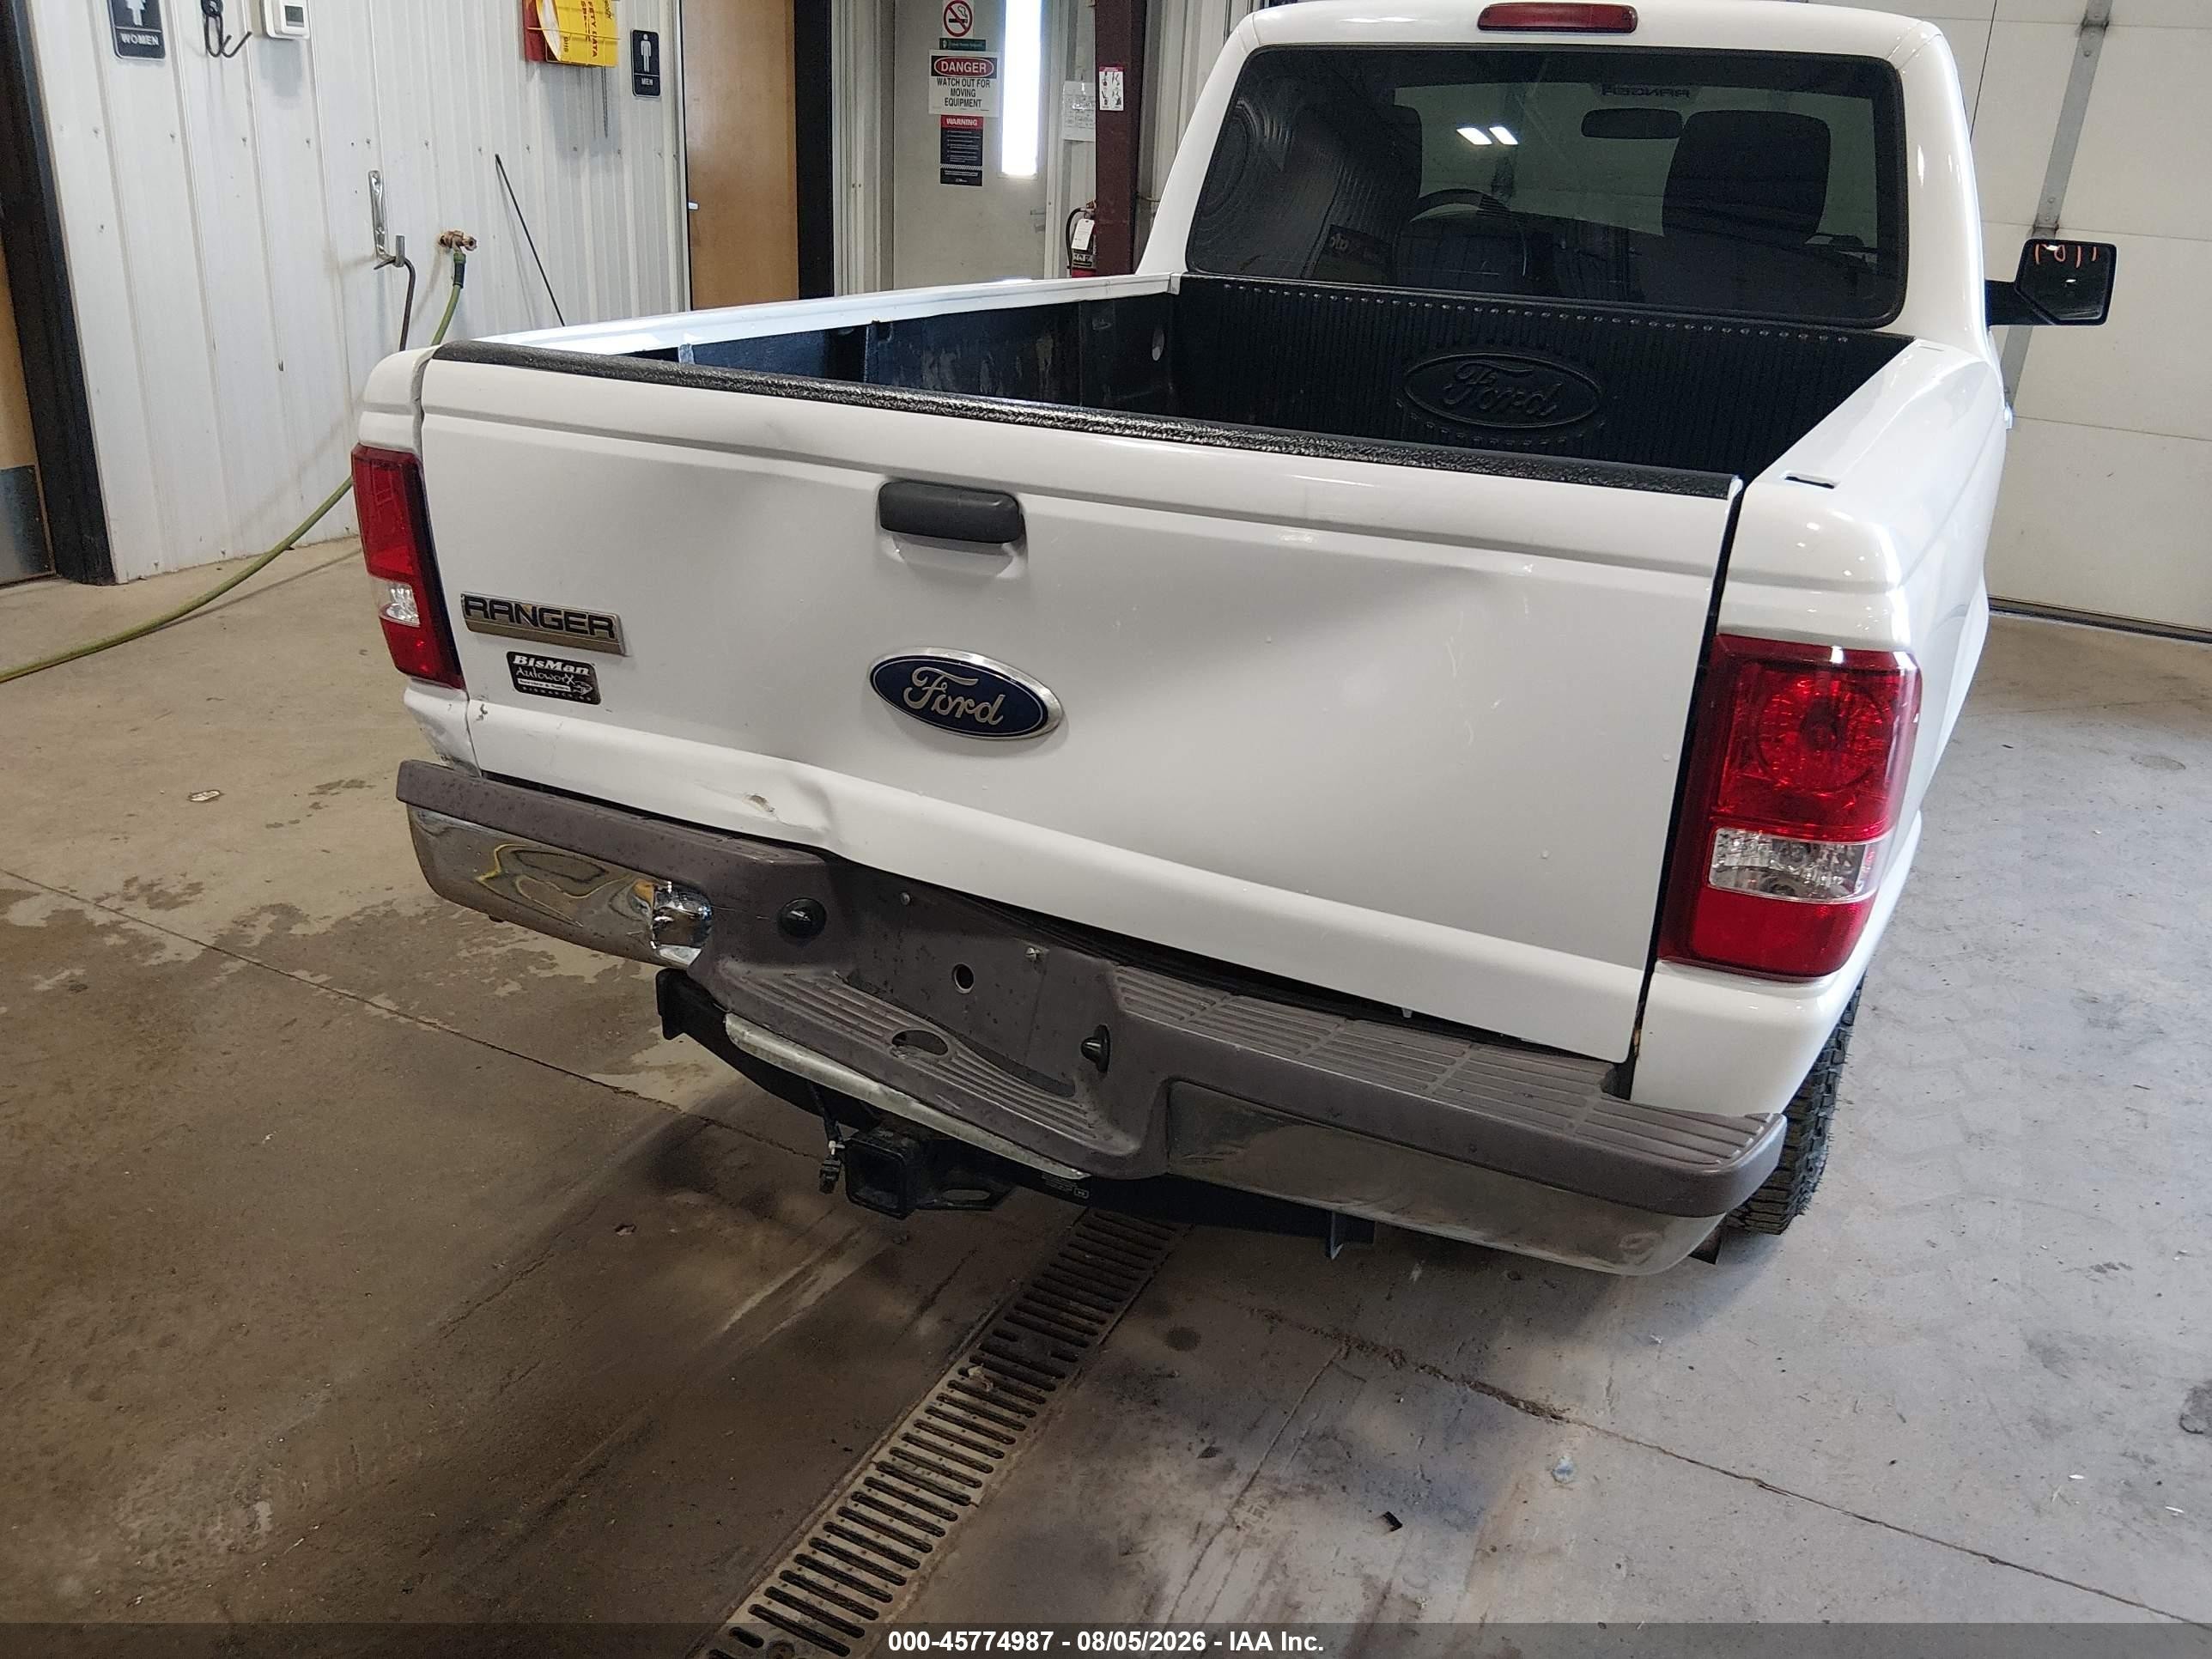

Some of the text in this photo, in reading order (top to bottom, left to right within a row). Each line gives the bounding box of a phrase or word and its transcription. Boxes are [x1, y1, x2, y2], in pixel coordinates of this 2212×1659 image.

[120, 33, 160, 46] WOMEN
[940, 61, 987, 74] DANGER
[641, 77, 653, 86] MEN
[937, 77, 991, 88] WATCH OUT FOR
[950, 88, 976, 98] MOVING
[945, 97, 982, 108] EQUIPMENT
[946, 118, 978, 126] WARNING
[1442, 359, 1564, 417] Ford
[465, 596, 616, 639] RANGER
[513, 655, 591, 677] BisMan
[902, 665, 1006, 726] Ford
